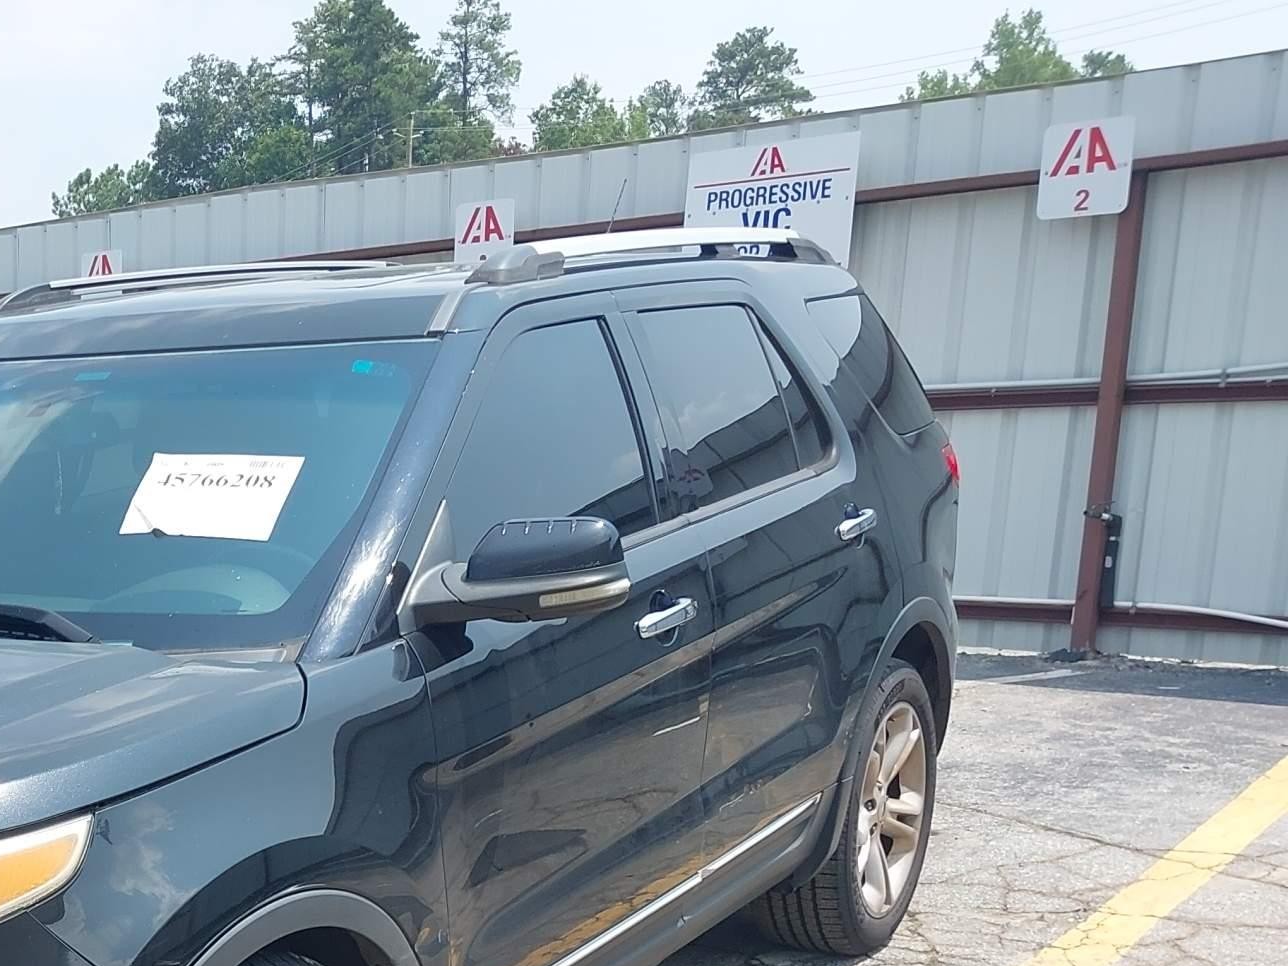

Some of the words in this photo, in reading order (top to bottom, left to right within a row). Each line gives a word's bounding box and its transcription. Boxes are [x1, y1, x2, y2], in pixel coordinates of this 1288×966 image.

[706, 177, 833, 211] PROGRESSIVE
[1073, 189, 1090, 212] 2
[157, 472, 277, 489] 45766208
